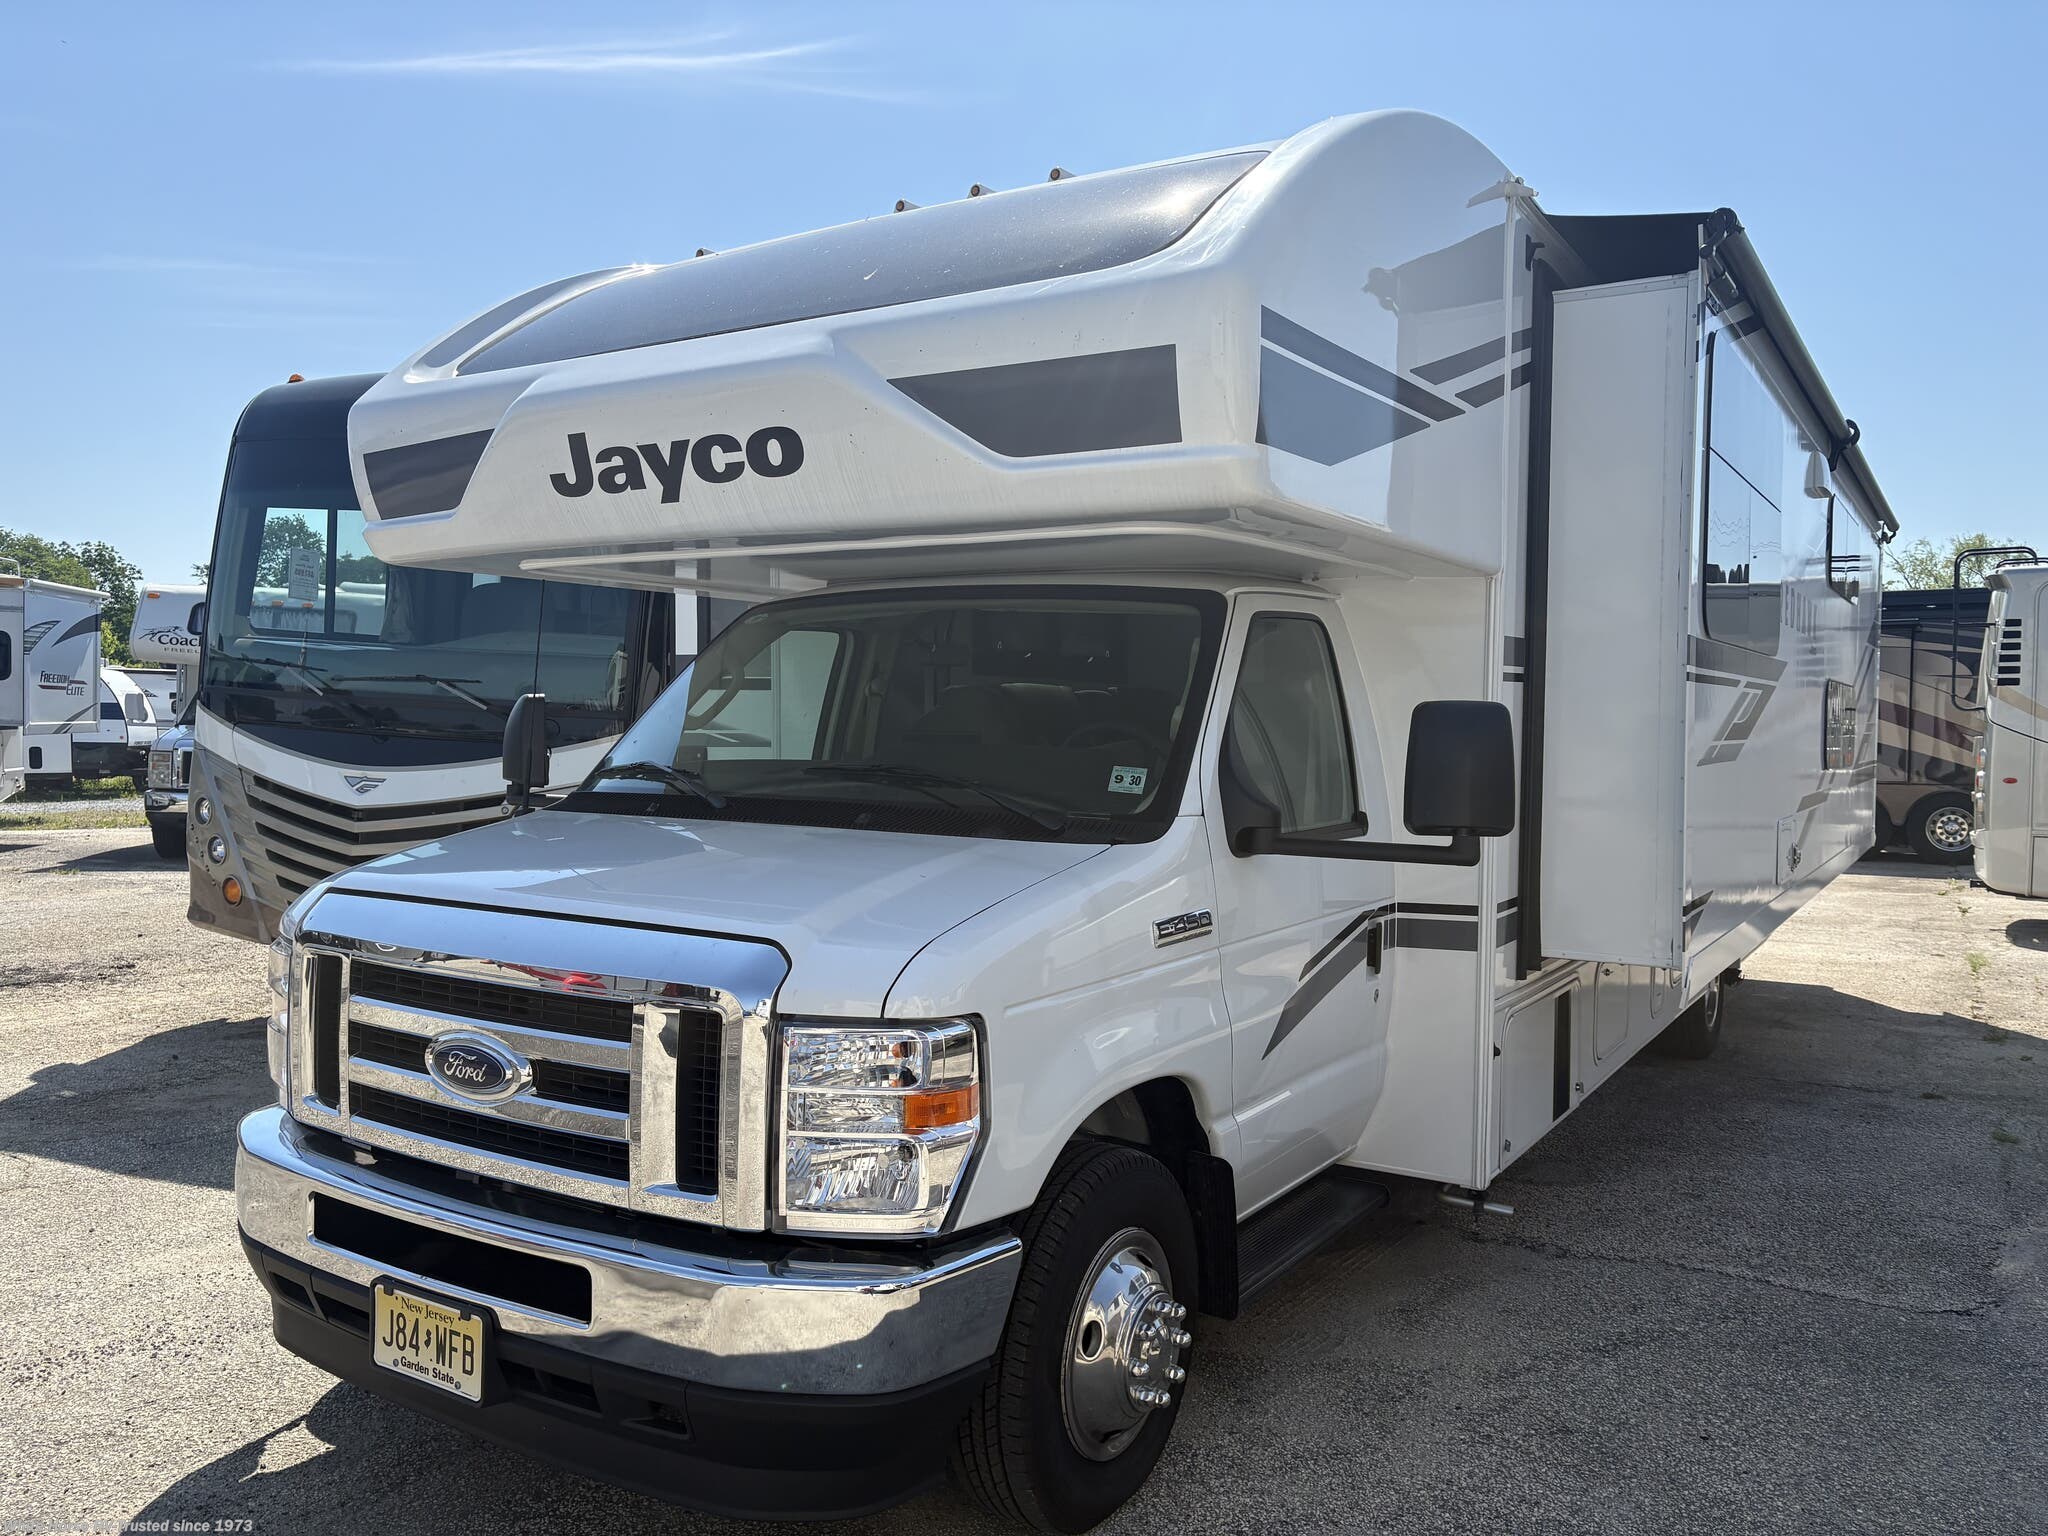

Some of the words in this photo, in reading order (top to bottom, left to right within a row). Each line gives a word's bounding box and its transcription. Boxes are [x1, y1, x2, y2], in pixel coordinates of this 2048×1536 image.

[549, 426, 804, 504] Jayco
[40, 671, 70, 683] FREEDOM
[66, 683, 85, 696] ELITE
[1114, 774, 1124, 784] 9
[1128, 775, 1142, 786] 30
[444, 1051, 487, 1082] Ford
[401, 1296, 424, 1315] New
[425, 1305, 455, 1327] Jersey
[401, 1356, 430, 1376] Garden
[432, 1367, 455, 1385] State
